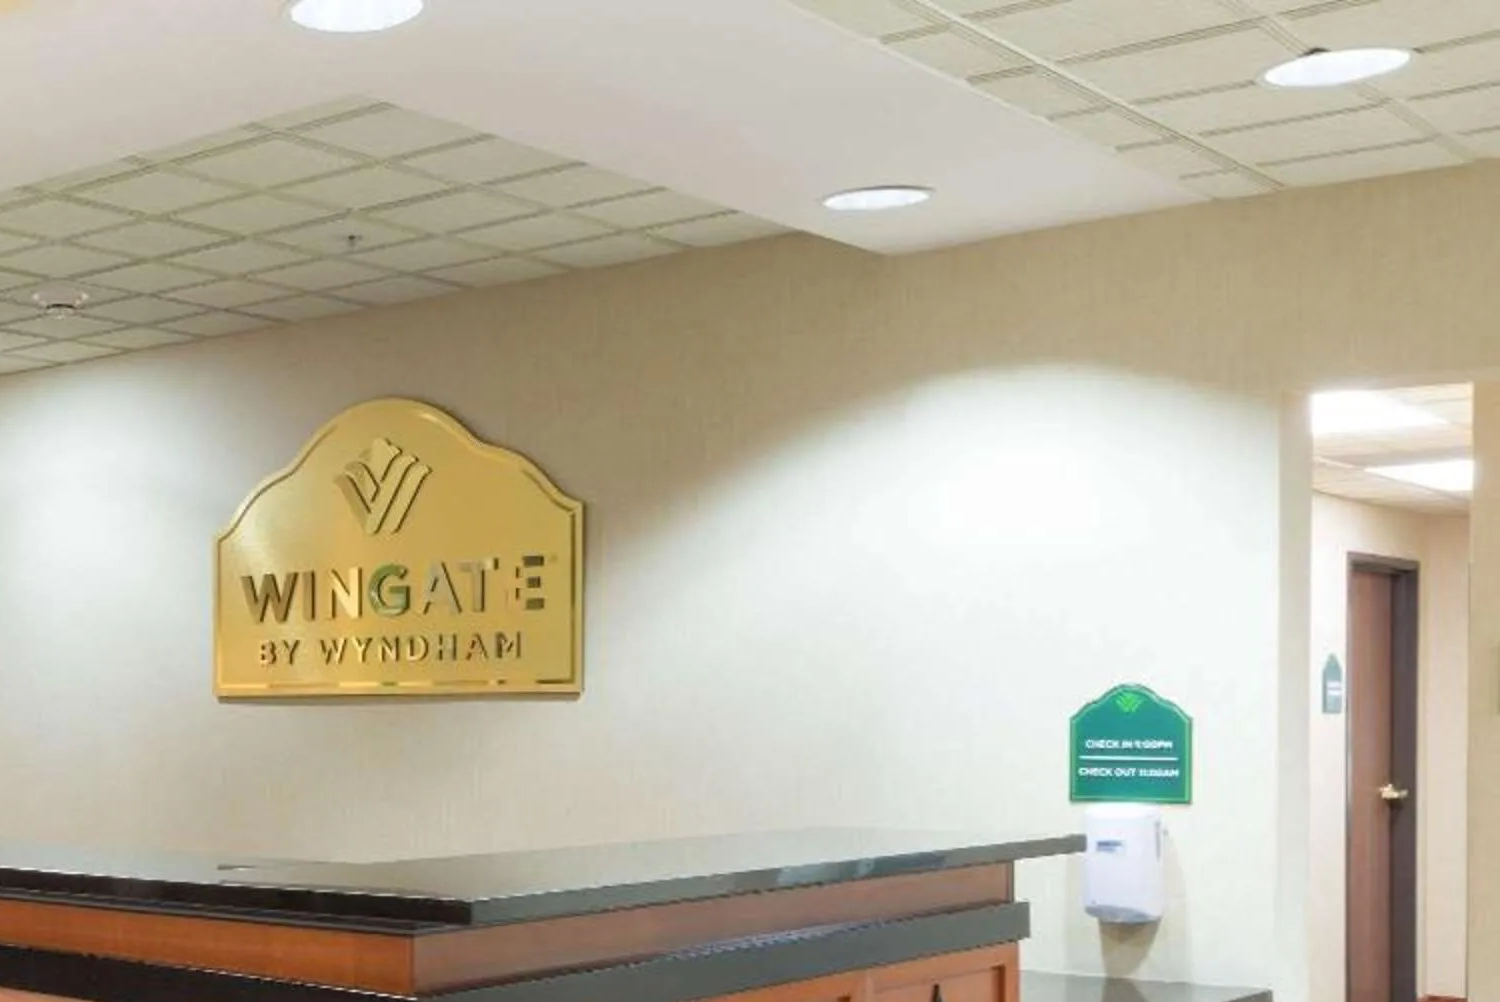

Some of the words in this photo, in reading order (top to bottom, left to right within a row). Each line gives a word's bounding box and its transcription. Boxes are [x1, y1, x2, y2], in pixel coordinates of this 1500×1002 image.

[240, 553, 546, 624] WINGATE
[260, 639, 300, 666] BY
[319, 630, 522, 665] WYNDHAM
[1085, 739, 1119, 749] CHECK
[1121, 740, 1133, 749] IN
[1079, 767, 1113, 777] CHECK
[1114, 767, 1137, 777] OUT
